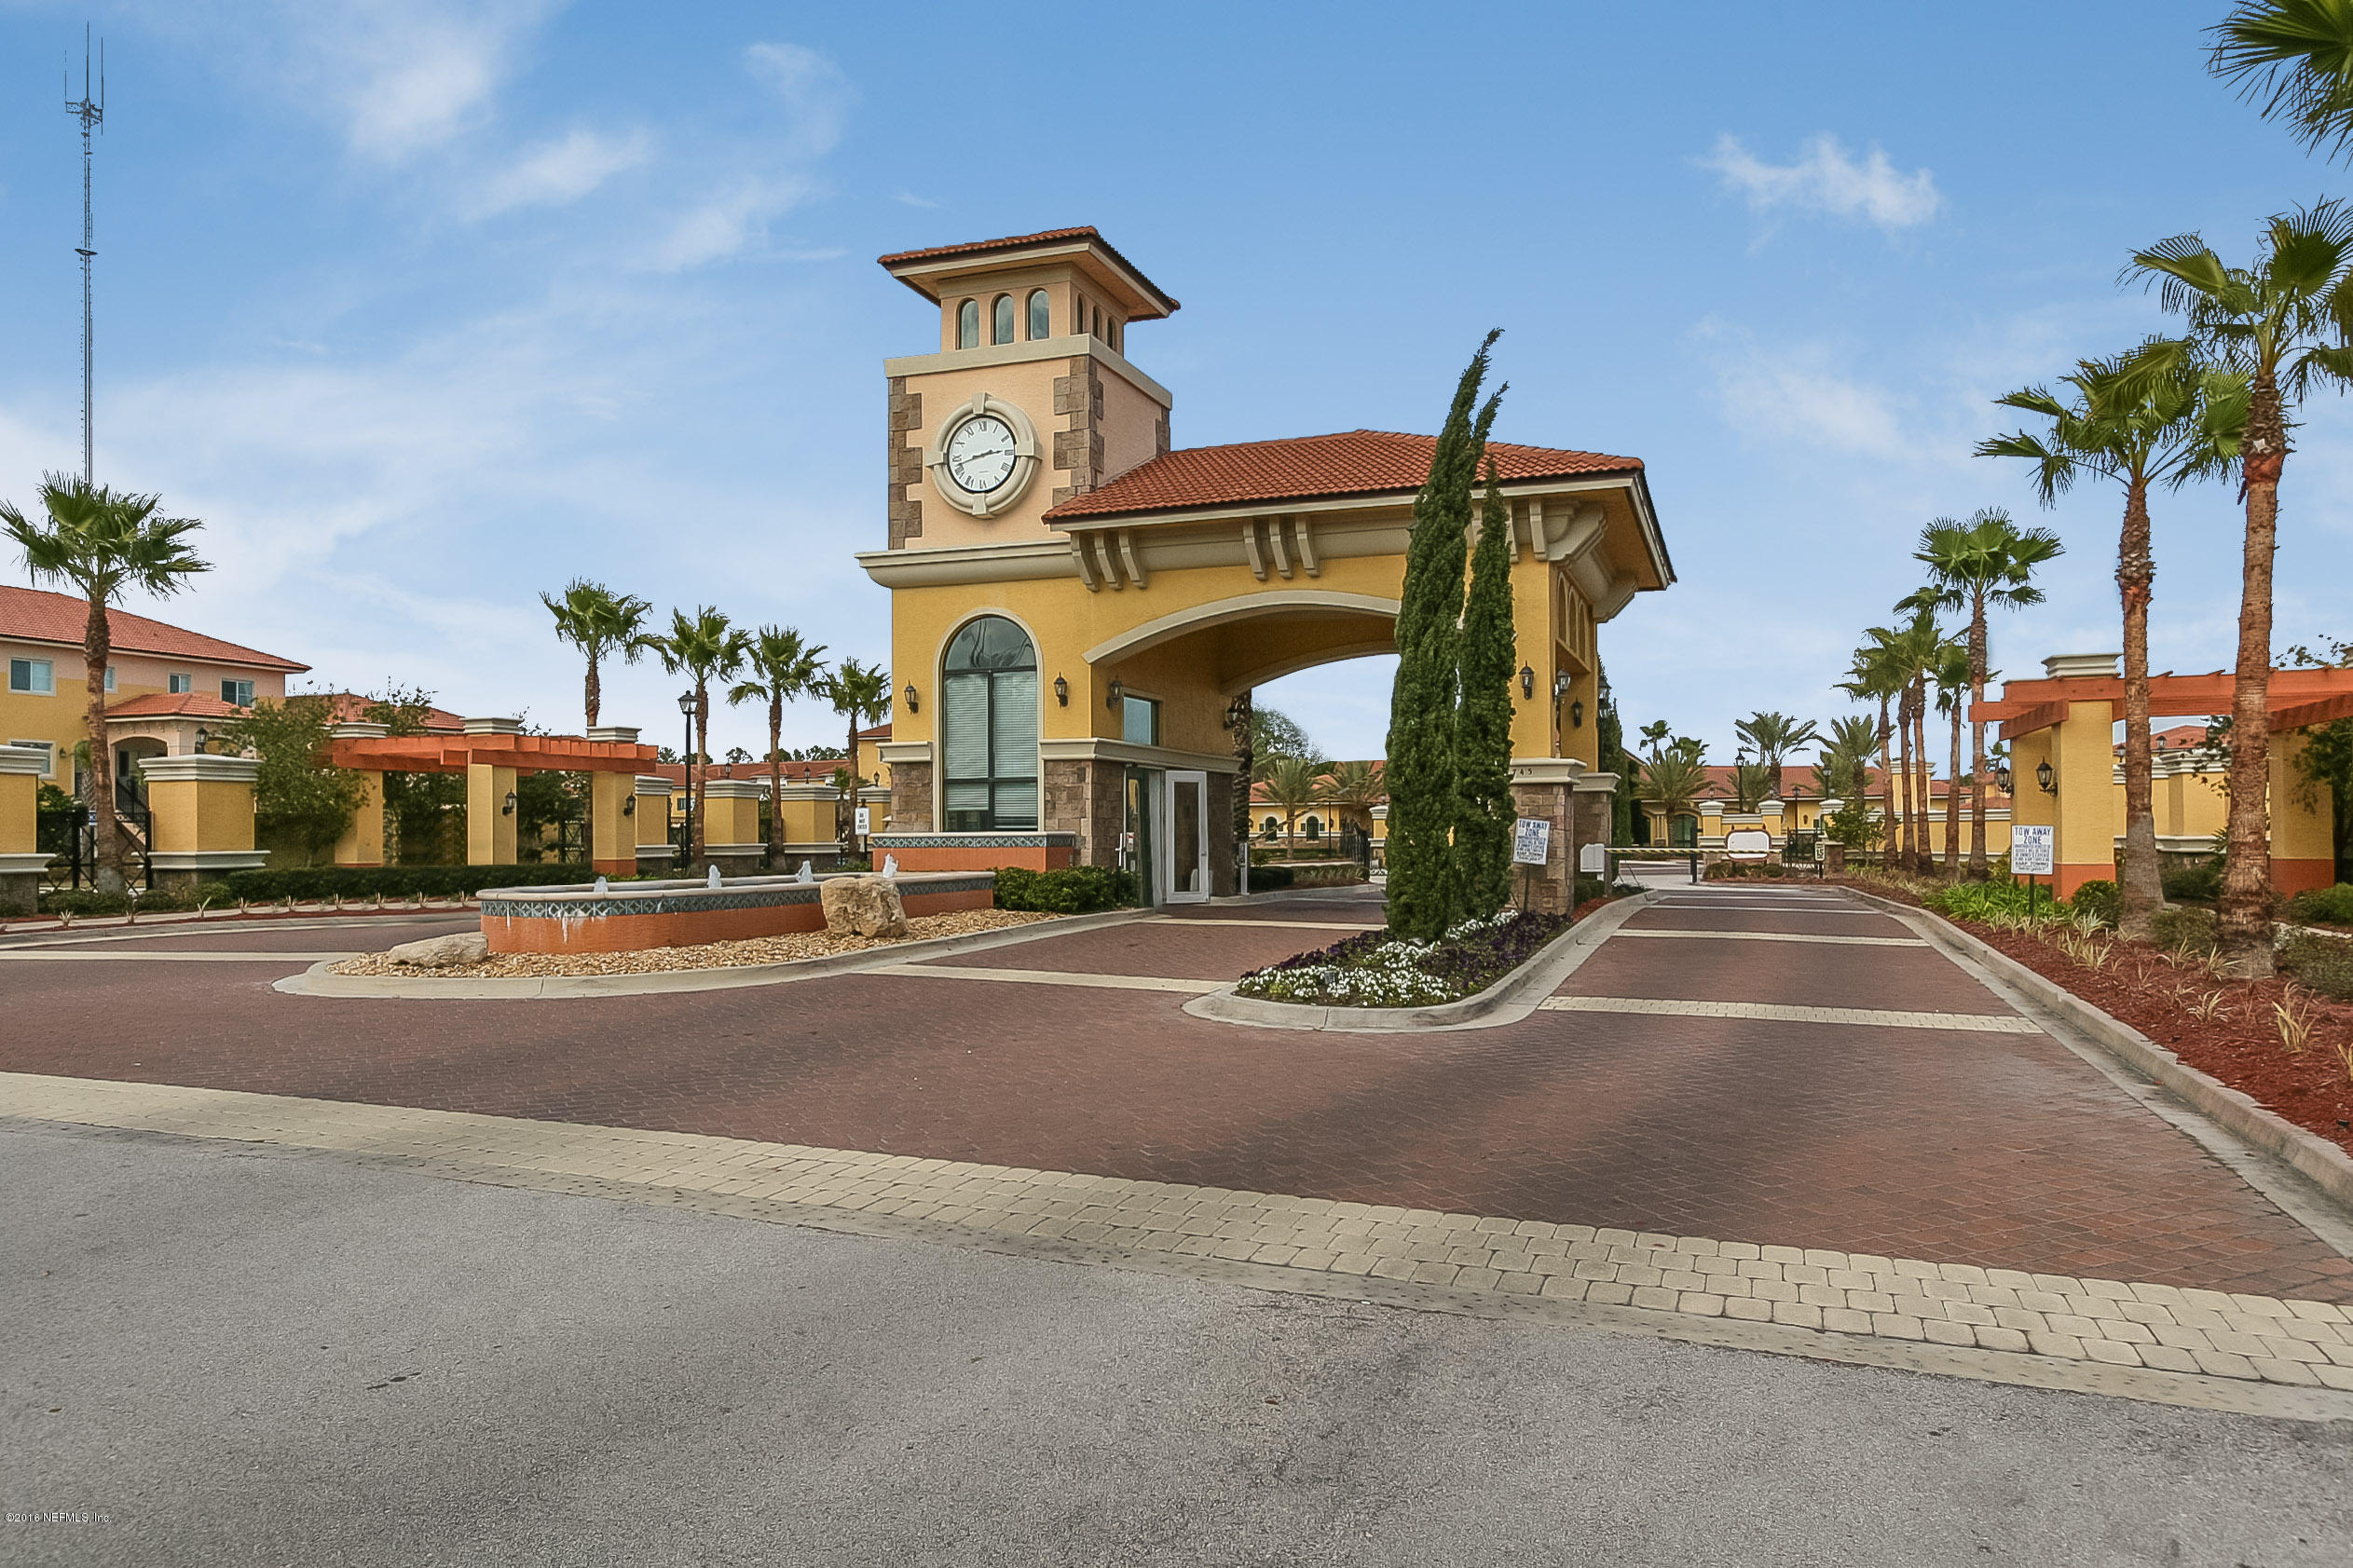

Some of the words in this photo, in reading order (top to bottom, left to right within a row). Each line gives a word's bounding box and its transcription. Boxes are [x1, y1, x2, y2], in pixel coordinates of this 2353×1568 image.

[2014, 826, 2030, 837] TOW
[2032, 826, 2051, 837] AWAY
[2023, 836, 2043, 846] ZONE
